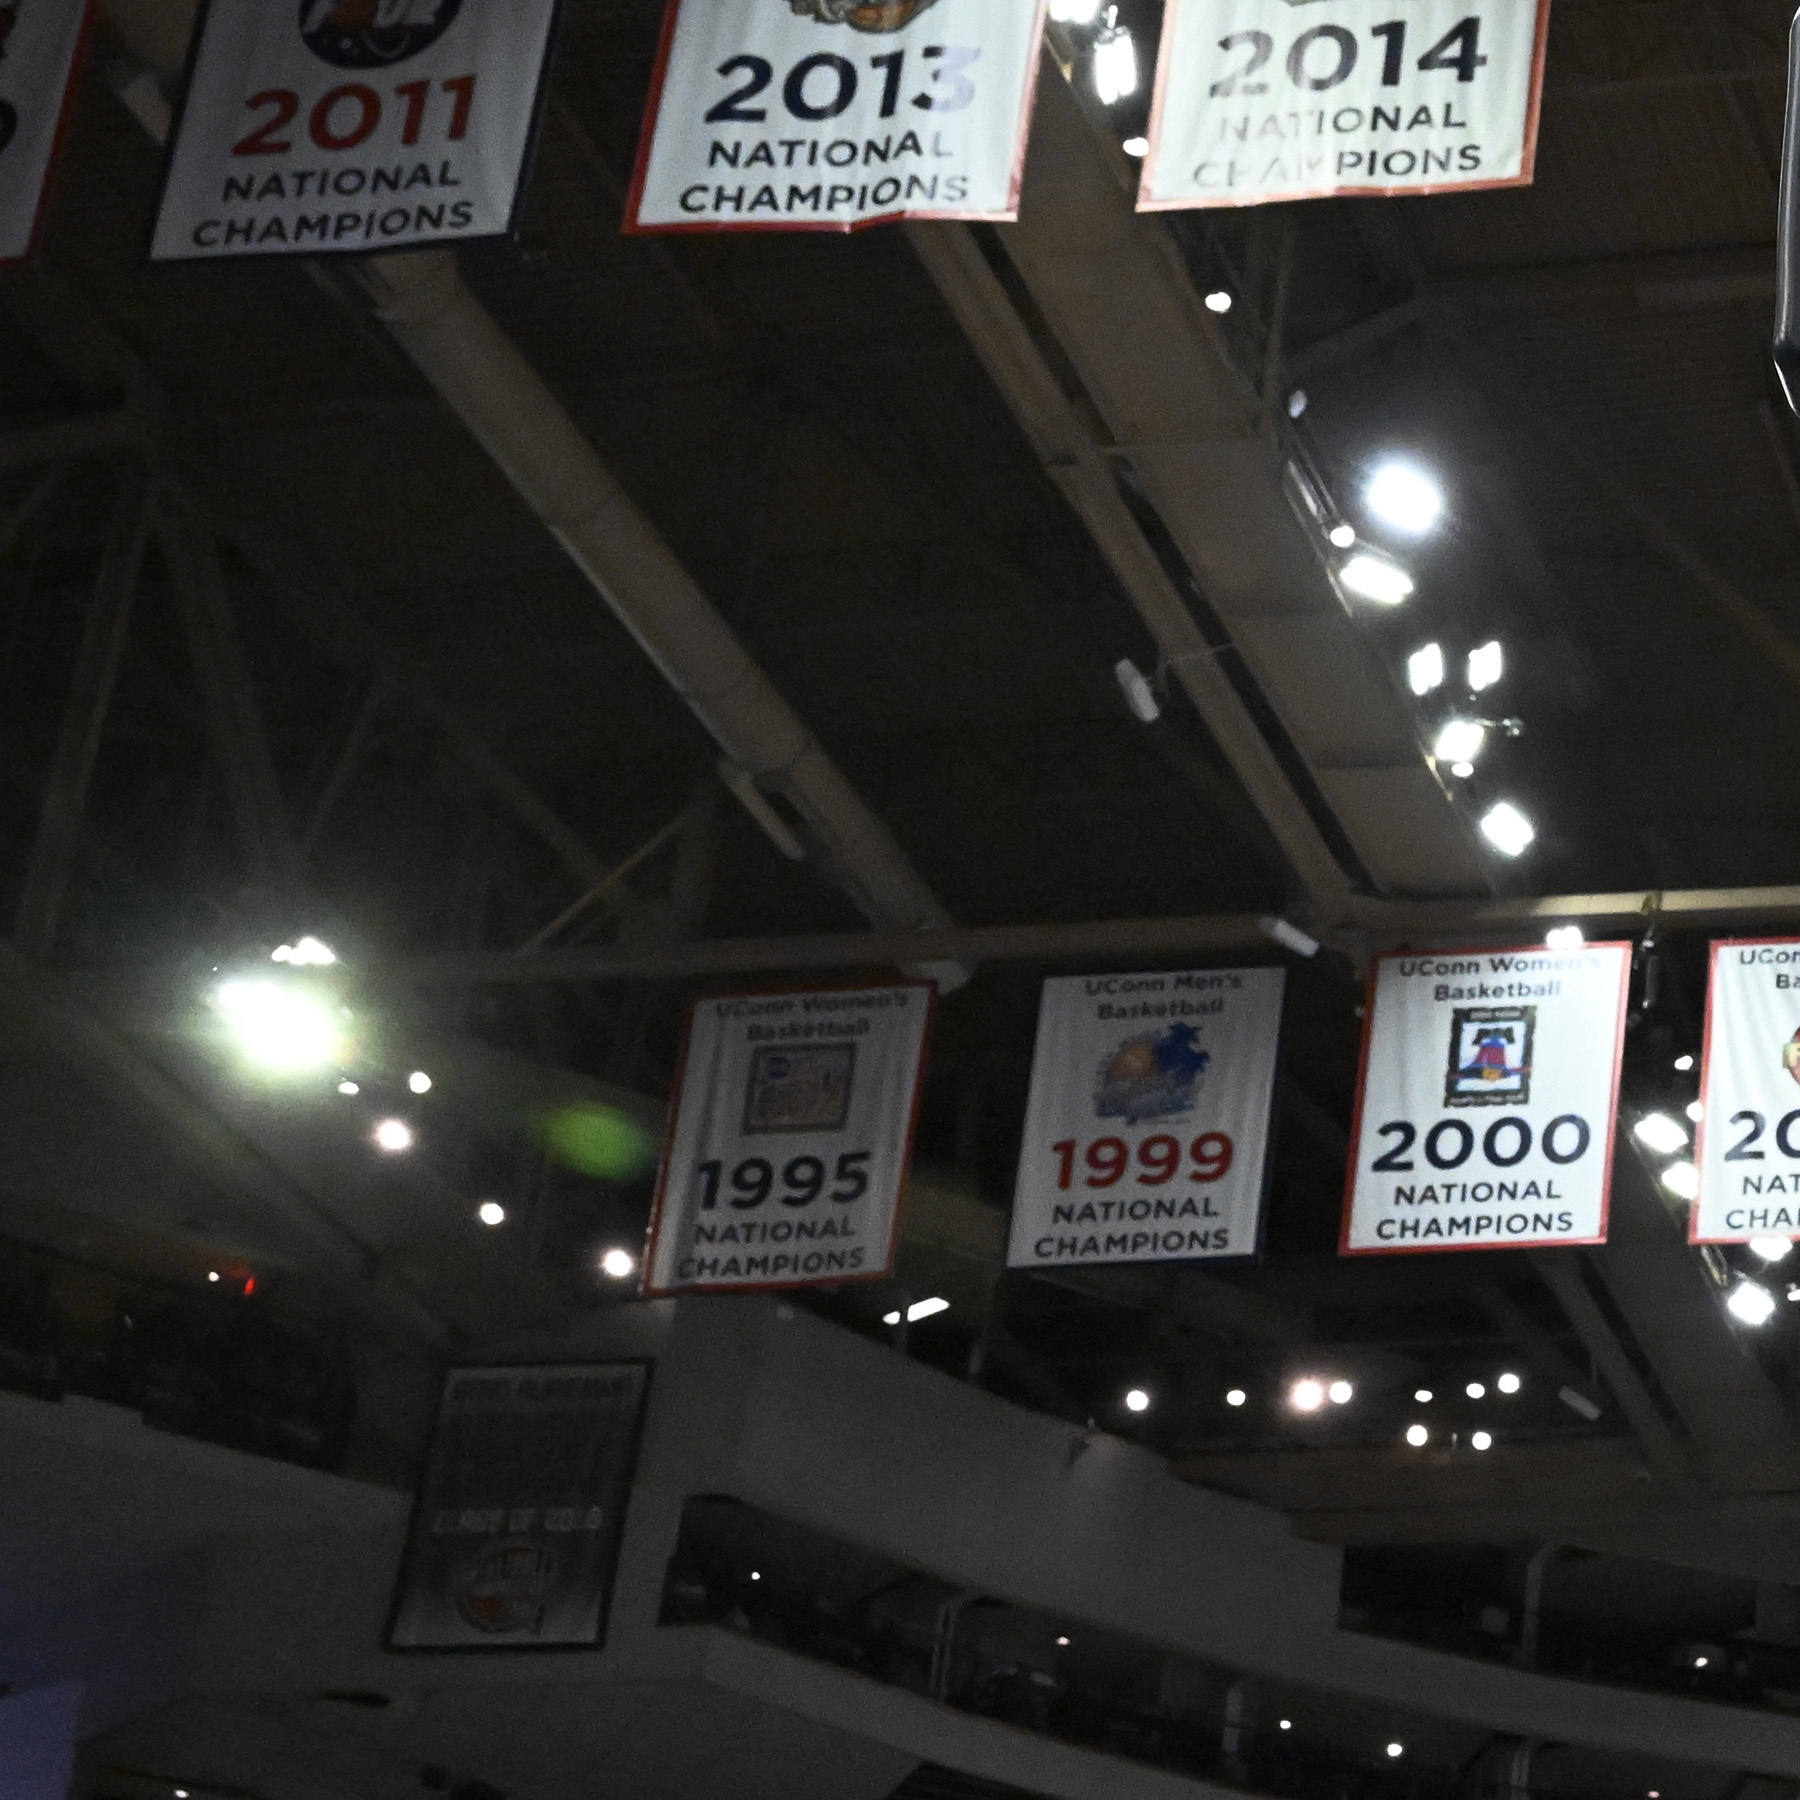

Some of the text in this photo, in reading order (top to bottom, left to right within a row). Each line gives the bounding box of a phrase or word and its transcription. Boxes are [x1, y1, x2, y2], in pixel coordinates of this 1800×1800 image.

[1209, 15, 1489, 99] 2014
[704, 44, 983, 125] 2013
[230, 73, 478, 157] 2011
[1218, 102, 1468, 144] NATIONAL
[708, 129, 955, 169] NATIONAL
[222, 160, 463, 203] NATIONAL
[679, 174, 969, 214] CHAMPIONS
[191, 201, 475, 249] CHAMPIONS
[1085, 972, 1244, 996] UConn Men's
[1399, 953, 1601, 978] UConn Women's
[1433, 979, 1563, 1002] Basketball
[1053, 1131, 1236, 1191] 1999
[1370, 1112, 1591, 1173] 2000
[698, 1151, 882, 1211] 1995
[1393, 1179, 1563, 1207] NATIONAL
[693, 1216, 856, 1245] NATIONAL
[1052, 1196, 1220, 1225] NATIONAL
[1375, 1211, 1574, 1241] CHAMPIONS
[676, 1247, 866, 1279] CHAMPIONS
[1034, 1228, 1231, 1259] CHAMPIONS
